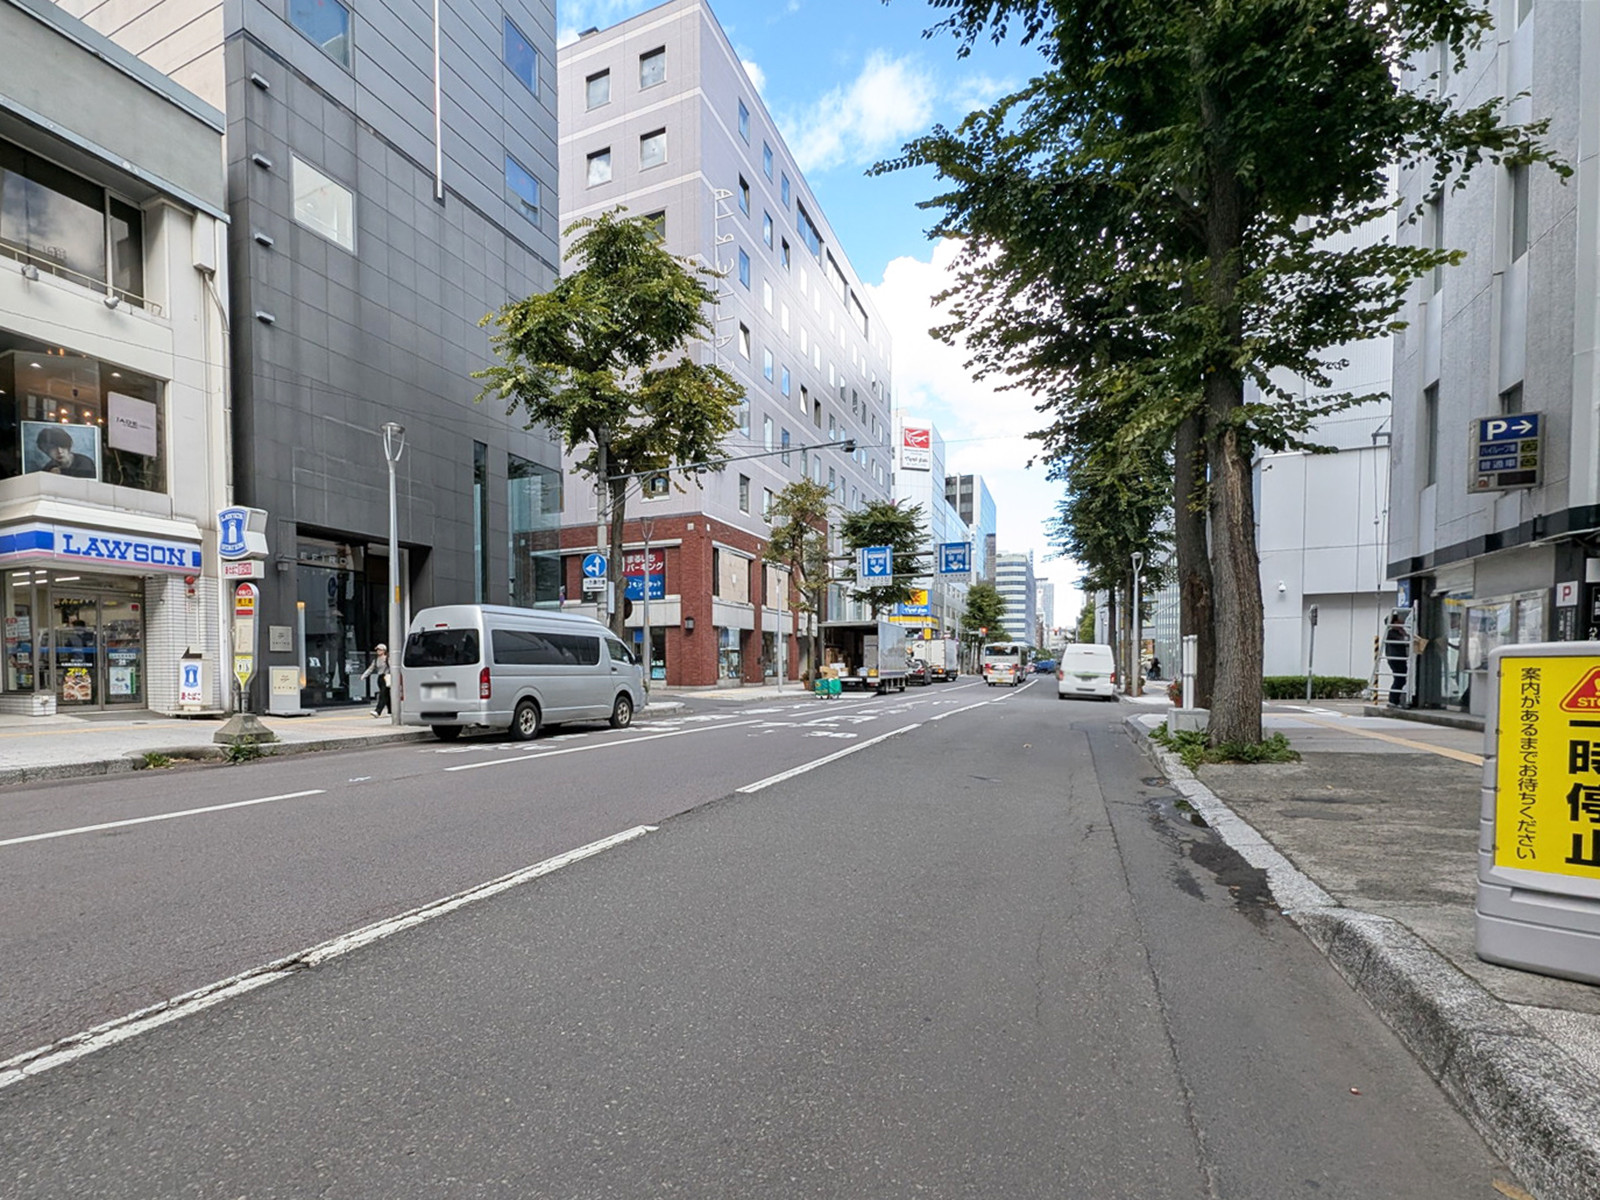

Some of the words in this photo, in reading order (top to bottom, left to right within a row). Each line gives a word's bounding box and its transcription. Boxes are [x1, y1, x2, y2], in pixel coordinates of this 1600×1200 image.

[1487, 420, 1507, 440] P
[62, 533, 186, 567] LAWSON
[1562, 585, 1572, 602] P
[1516, 667, 1541, 860] 案内があるまでお待ちください
